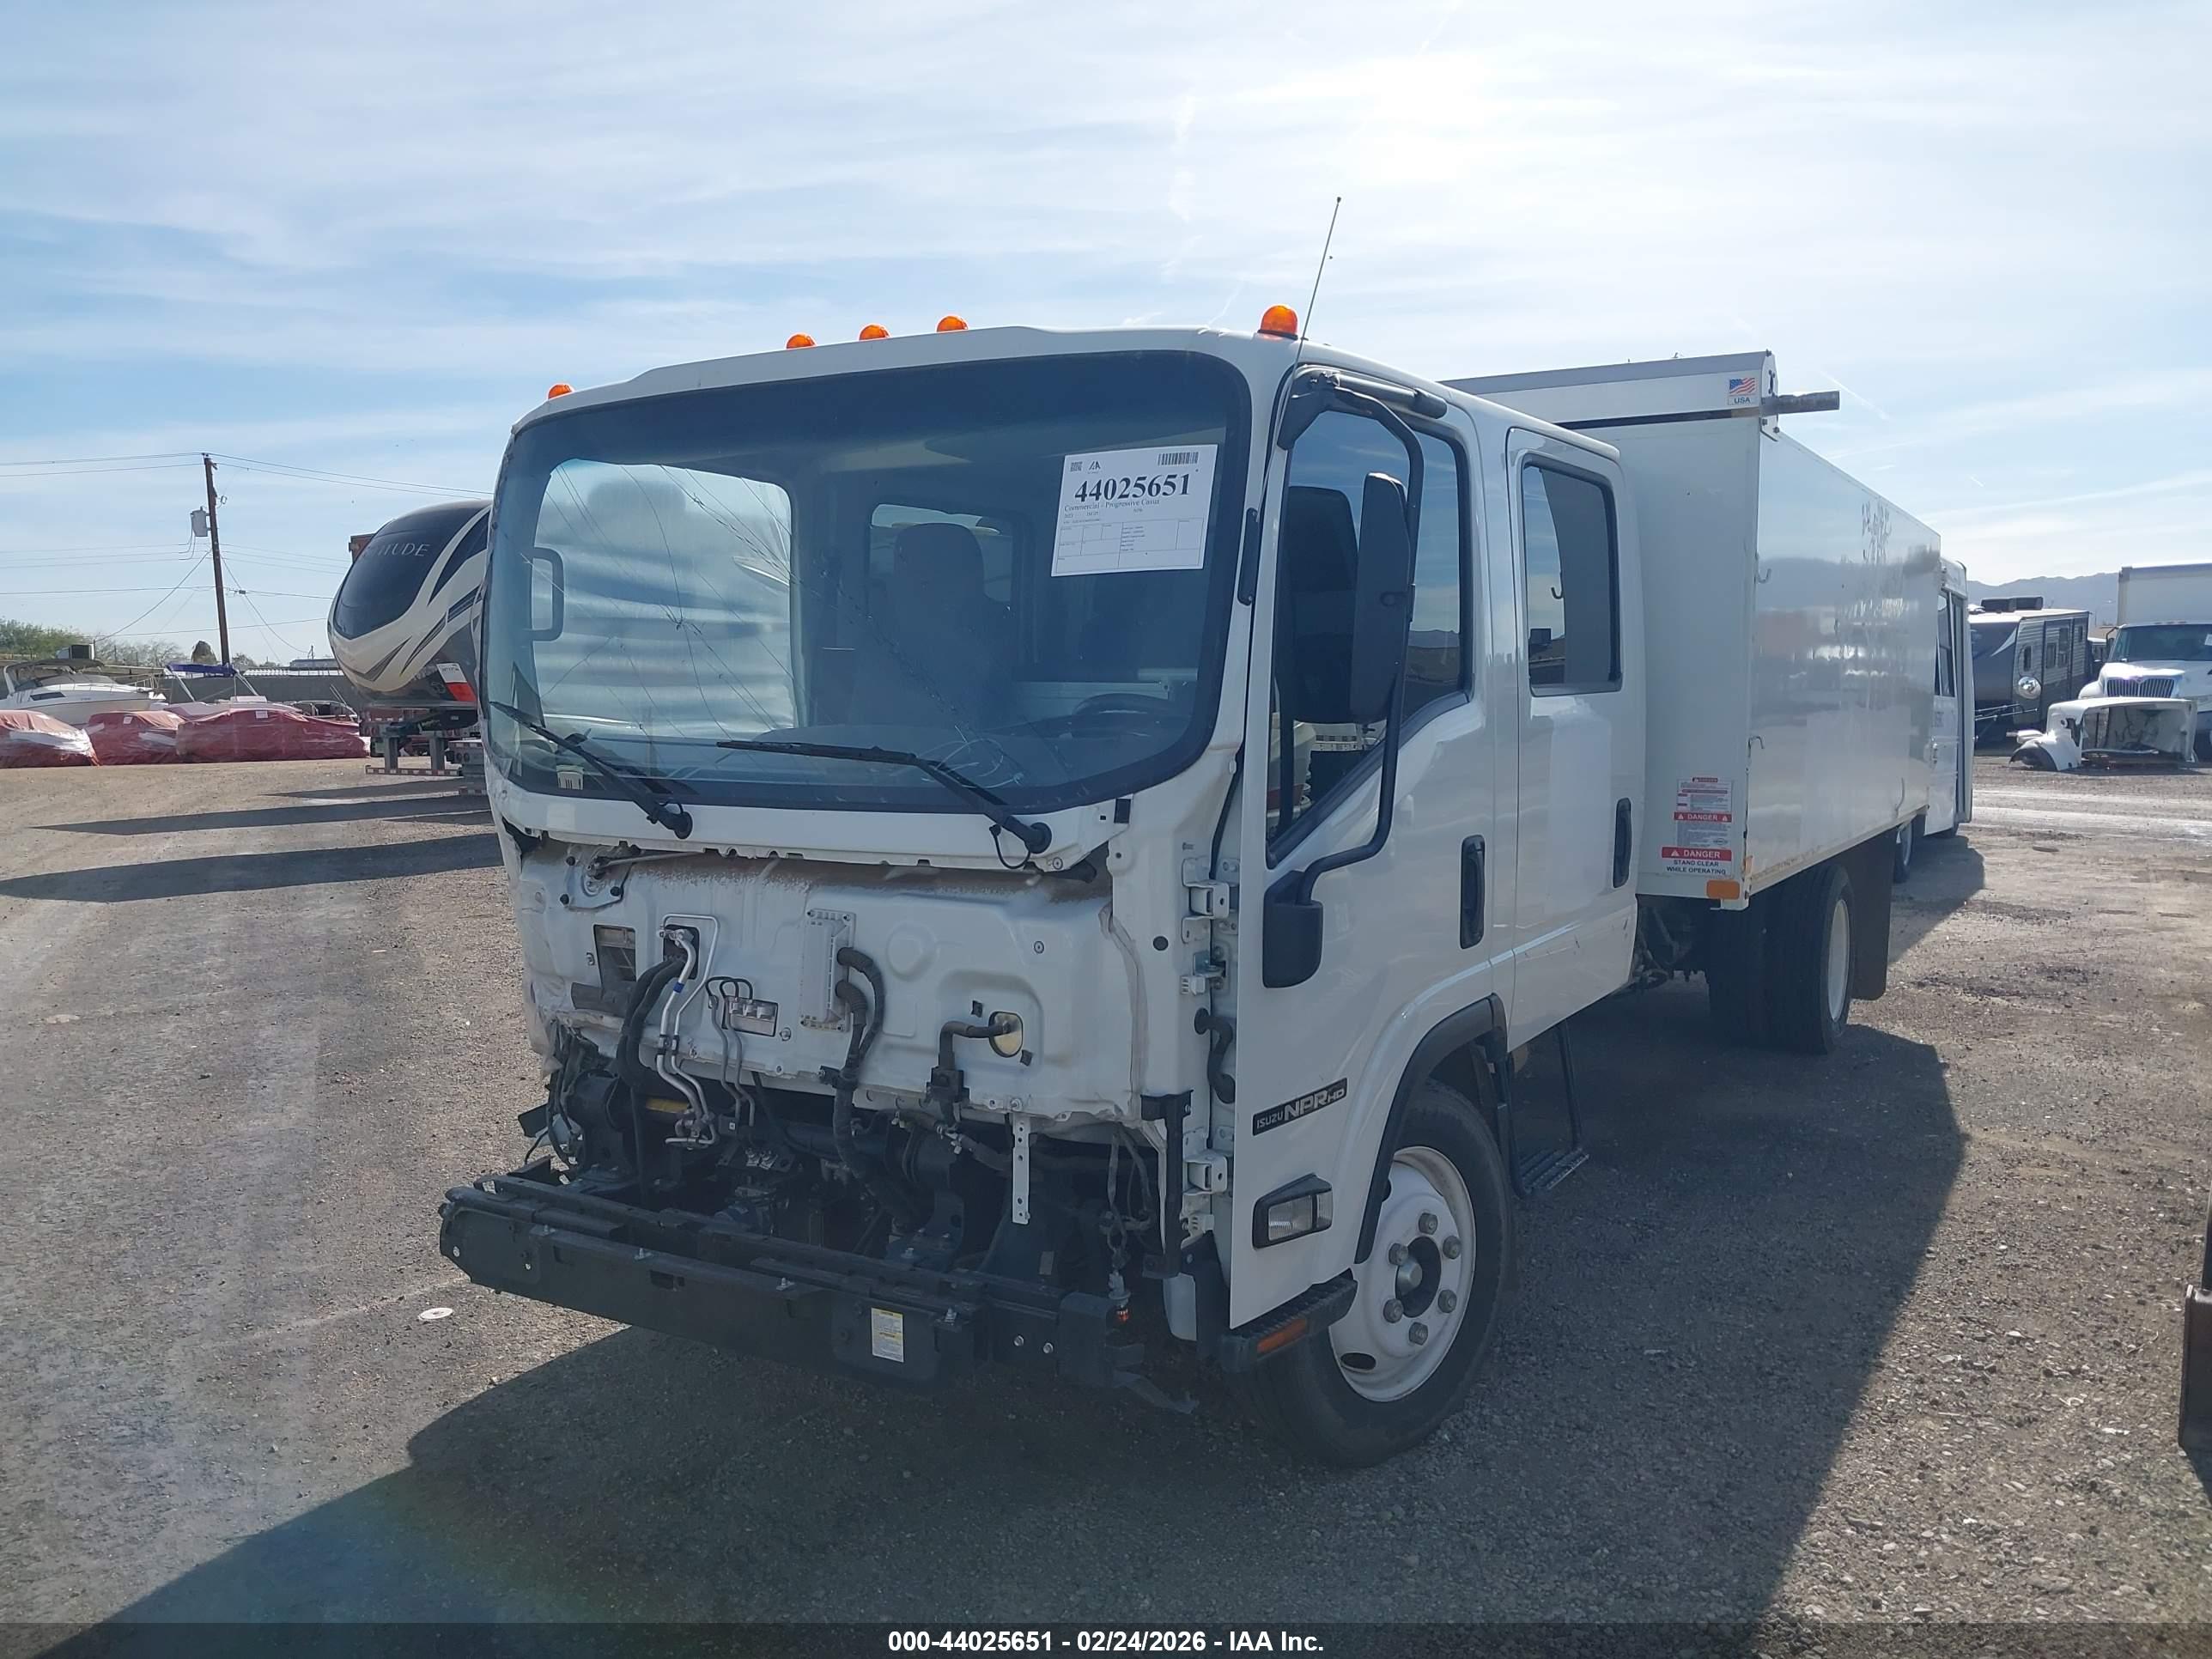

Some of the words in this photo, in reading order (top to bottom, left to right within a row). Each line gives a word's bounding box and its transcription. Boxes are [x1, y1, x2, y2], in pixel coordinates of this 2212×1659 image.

[1074, 473, 1190, 502] 44025651
[1064, 502, 1100, 513] Commercial
[1683, 850, 1721, 859] DANGER
[1256, 1110, 1284, 1129] ISUZU
[1284, 1090, 1328, 1121] NPR
